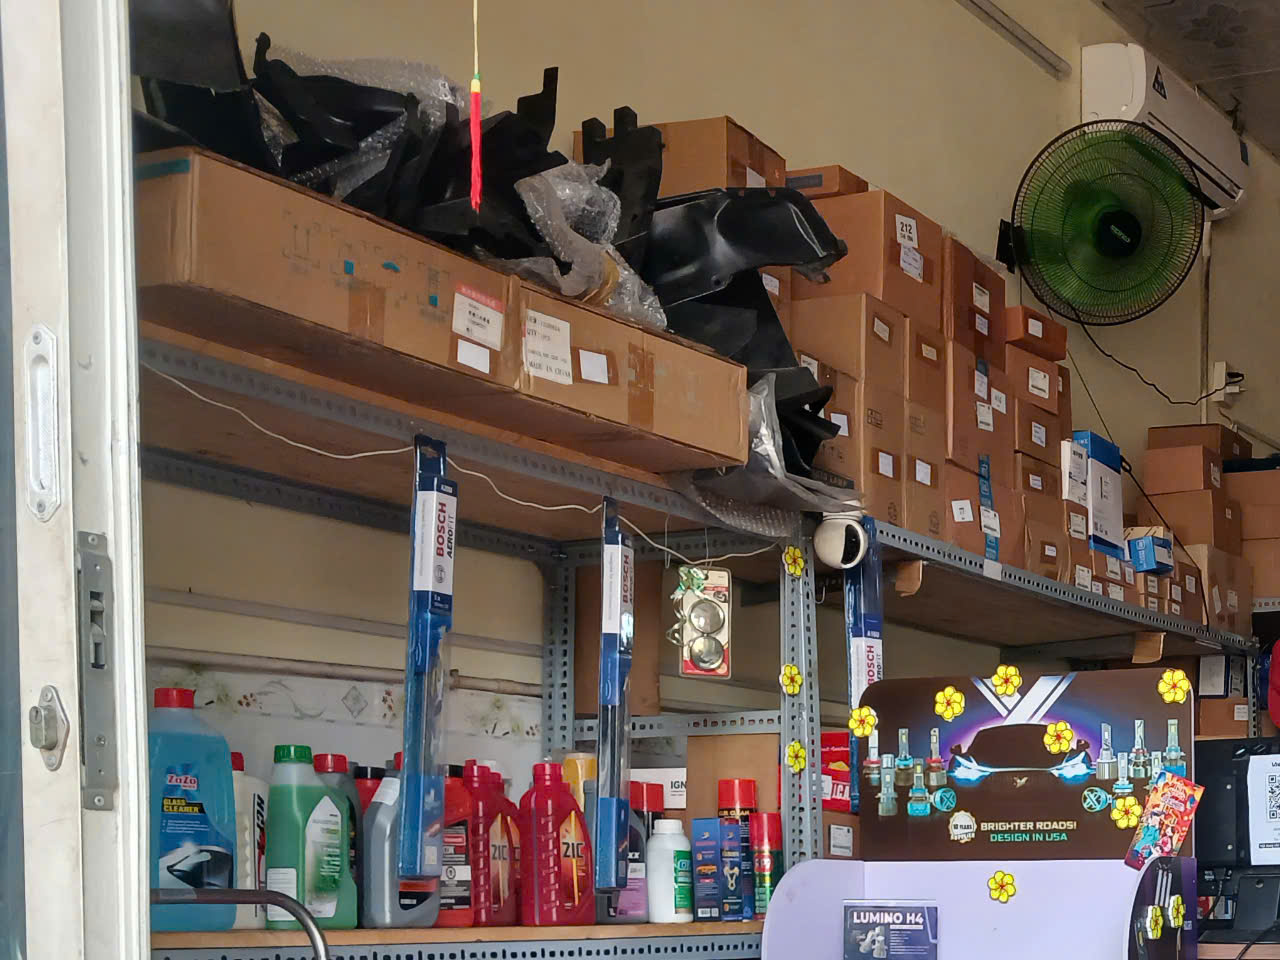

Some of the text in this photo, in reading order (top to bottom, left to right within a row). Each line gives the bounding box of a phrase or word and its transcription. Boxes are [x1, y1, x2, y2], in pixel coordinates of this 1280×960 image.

[900, 222, 912, 234] 212
[436, 502, 447, 557] BOSCH
[446, 515, 455, 559] AEROFIT
[622, 554, 630, 604] BOSCH
[163, 798, 187, 806] GLASS
[163, 805, 200, 813] CLEANER
[980, 821, 1077, 831] BRIGHTER ROADS!
[990, 832, 1068, 842] DESIGN IN USA
[491, 845, 508, 861] ZIC
[562, 842, 584, 858] ZIC
[853, 911, 924, 924] LUMINO H4
